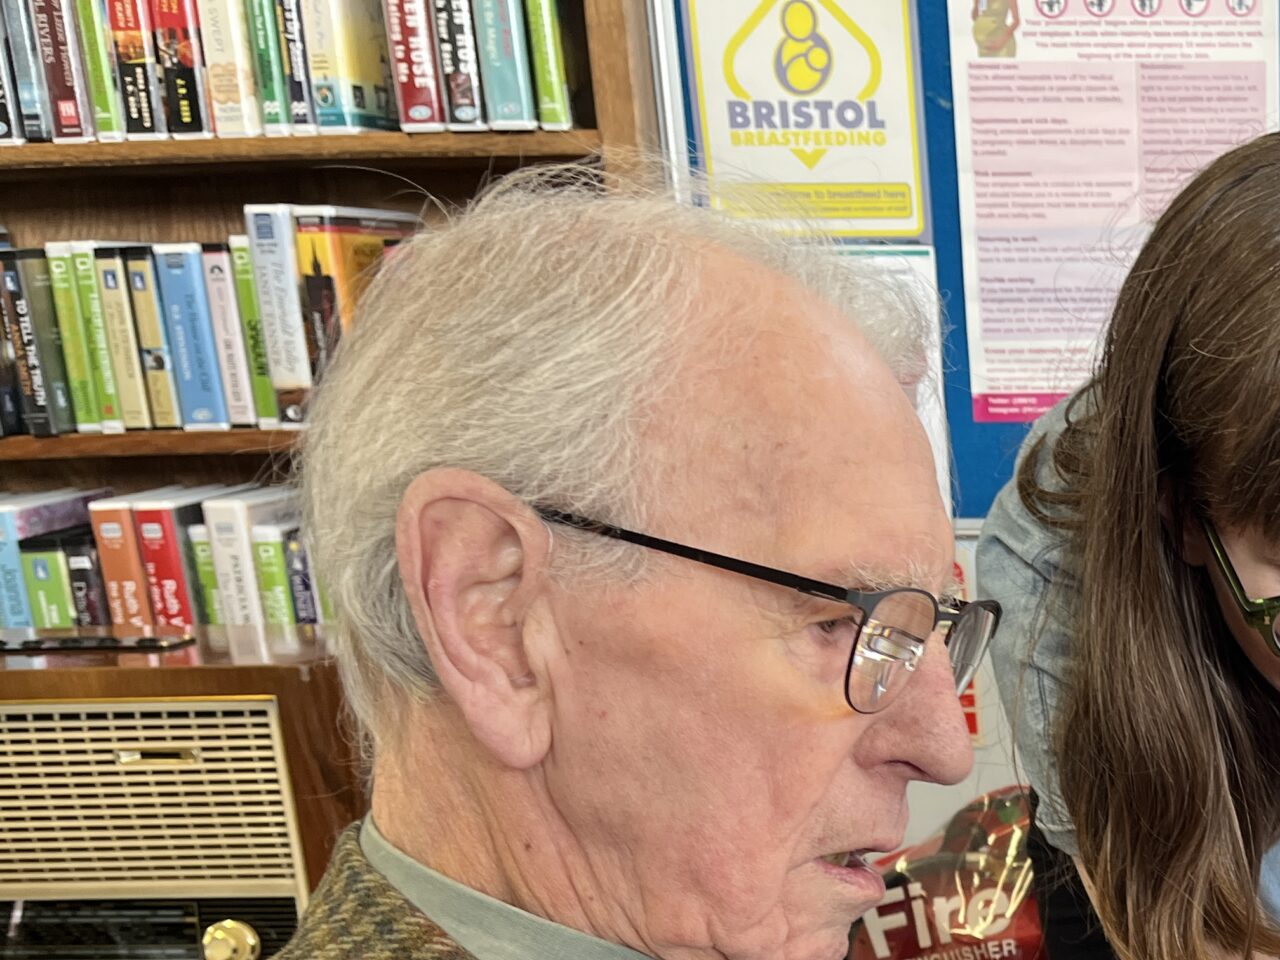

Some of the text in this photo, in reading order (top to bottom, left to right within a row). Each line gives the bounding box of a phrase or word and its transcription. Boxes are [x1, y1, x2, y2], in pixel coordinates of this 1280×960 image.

[38, 14, 55, 63] RIVERS
[208, 8, 224, 53] SWEPT
[394, 45, 405, 59] to
[441, 43, 455, 74] Back
[397, 62, 409, 83] Me
[727, 100, 886, 129] BRISTOL
[730, 131, 887, 147] BREASTFEEDING
[15, 299, 47, 405] TO TELL THE TRUTH
[123, 580, 138, 614] Ruth
[161, 579, 180, 614] Ruth
[862, 881, 1011, 960] Fire
